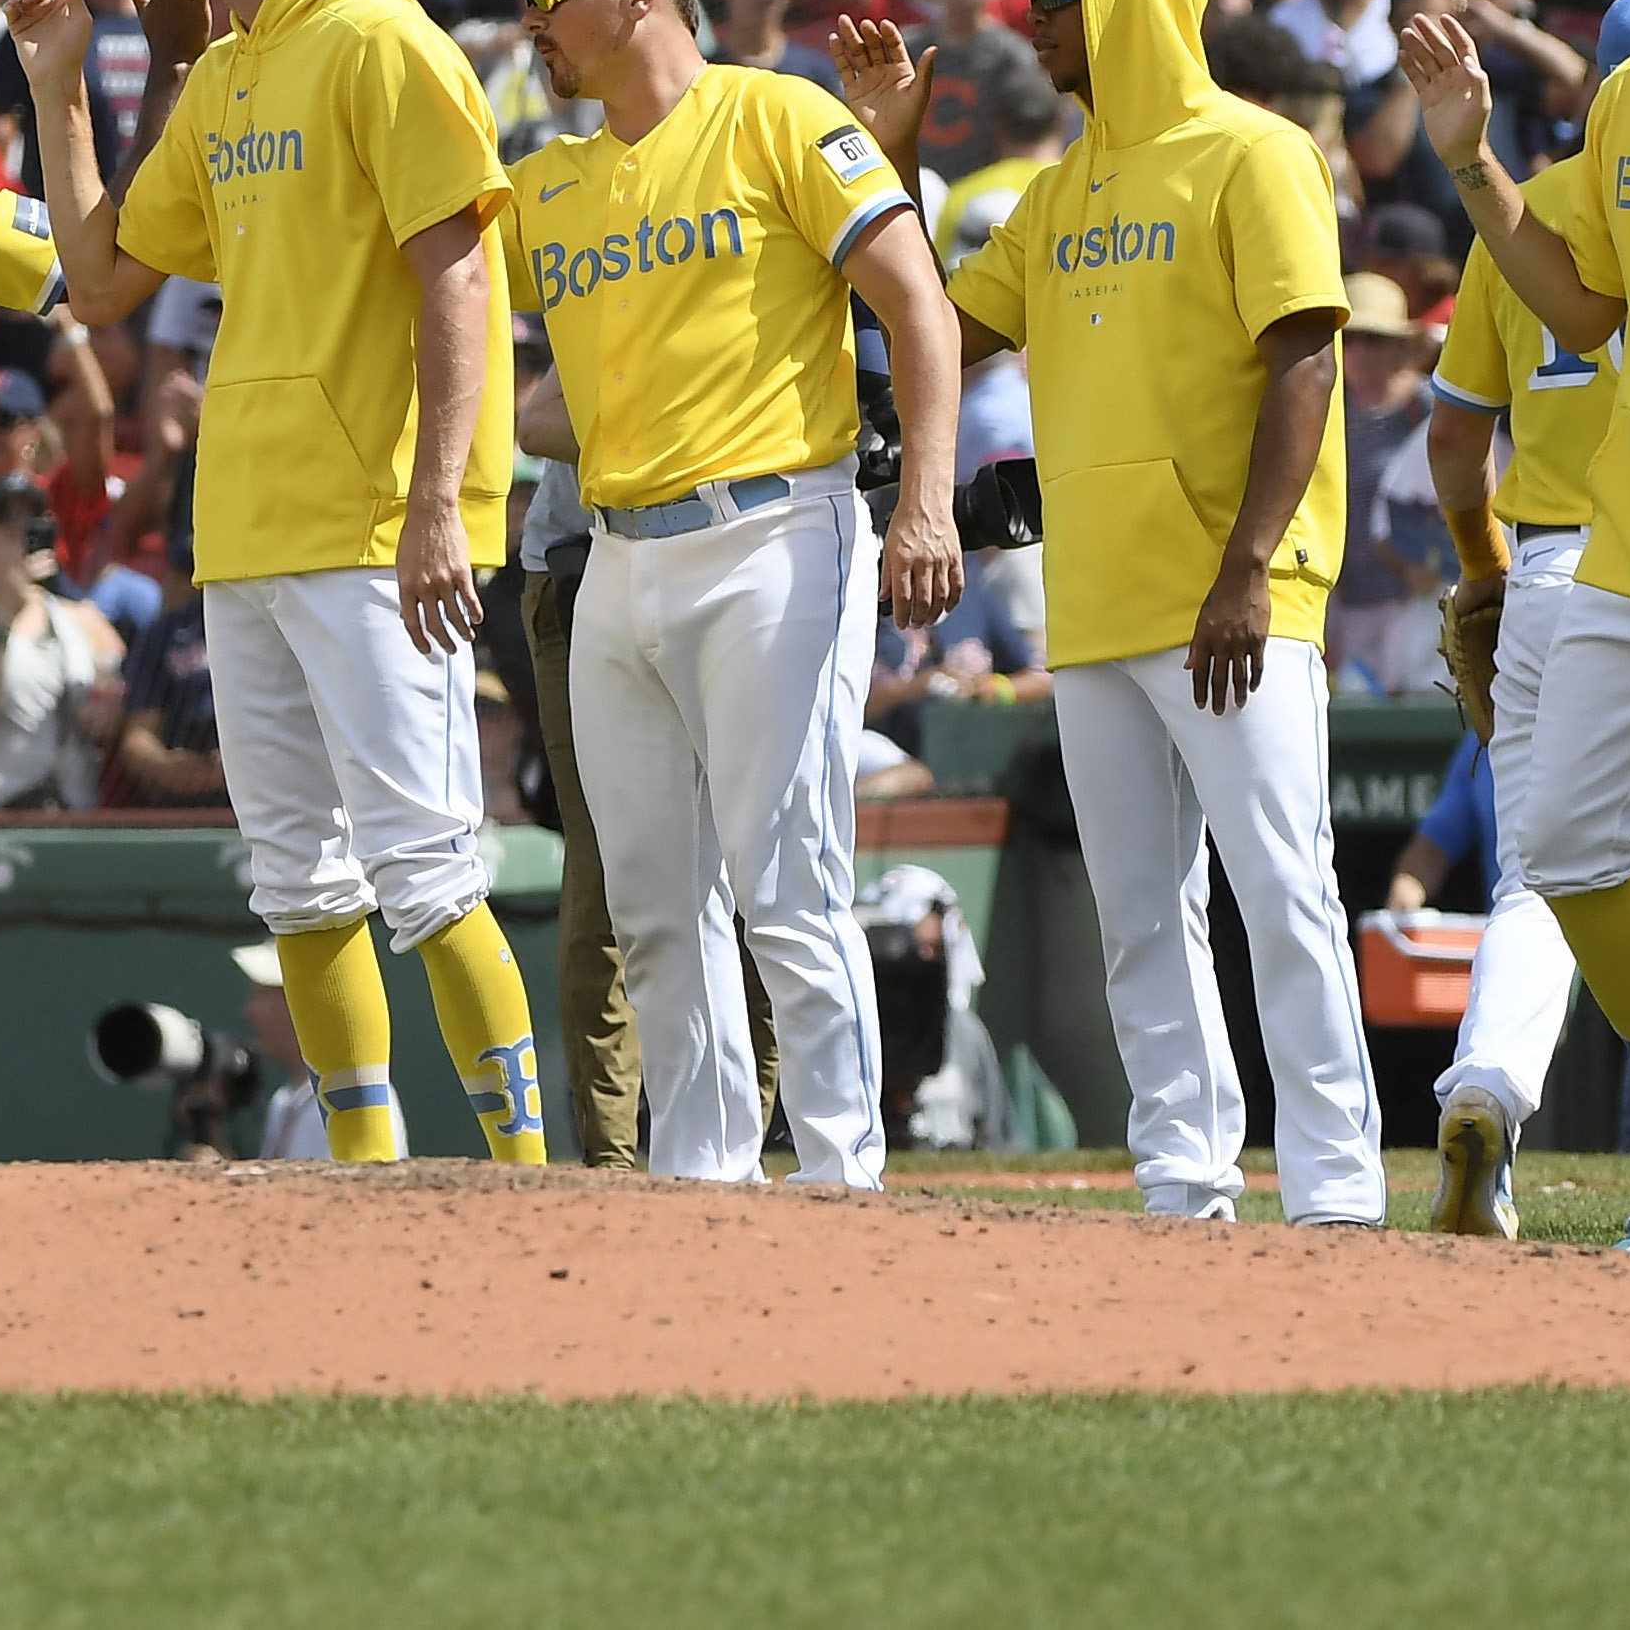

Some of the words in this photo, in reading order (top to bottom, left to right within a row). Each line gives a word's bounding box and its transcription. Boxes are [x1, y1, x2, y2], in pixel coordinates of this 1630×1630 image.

[839, 136, 870, 161] 617
[530, 206, 744, 313] Boston
[1048, 212, 1176, 276] oston
